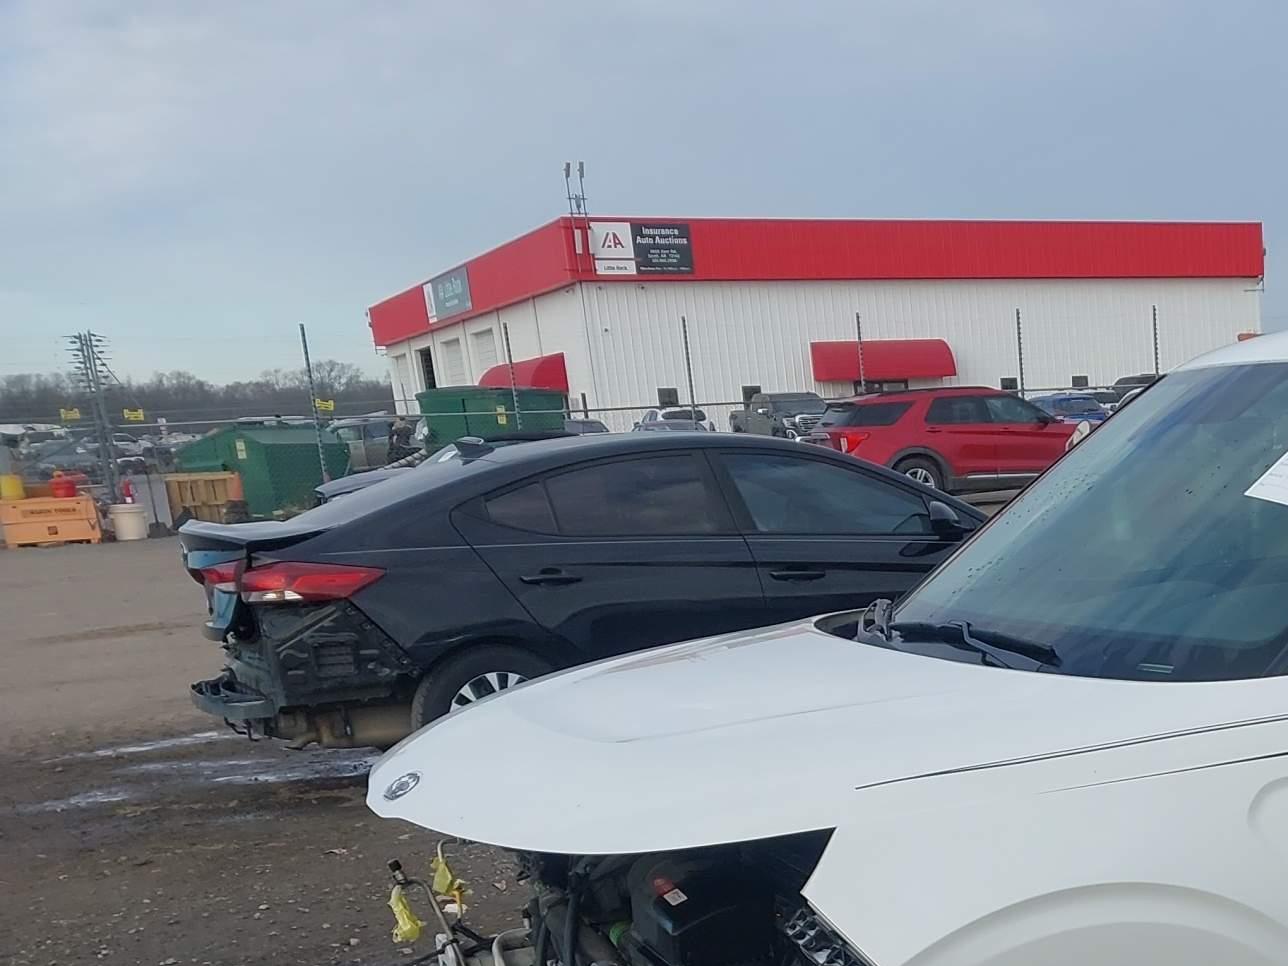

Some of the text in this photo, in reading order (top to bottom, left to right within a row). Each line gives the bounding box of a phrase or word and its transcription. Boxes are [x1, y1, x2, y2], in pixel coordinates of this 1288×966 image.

[642, 226, 680, 235] Insurance
[636, 236, 688, 244] Auto Auctions
